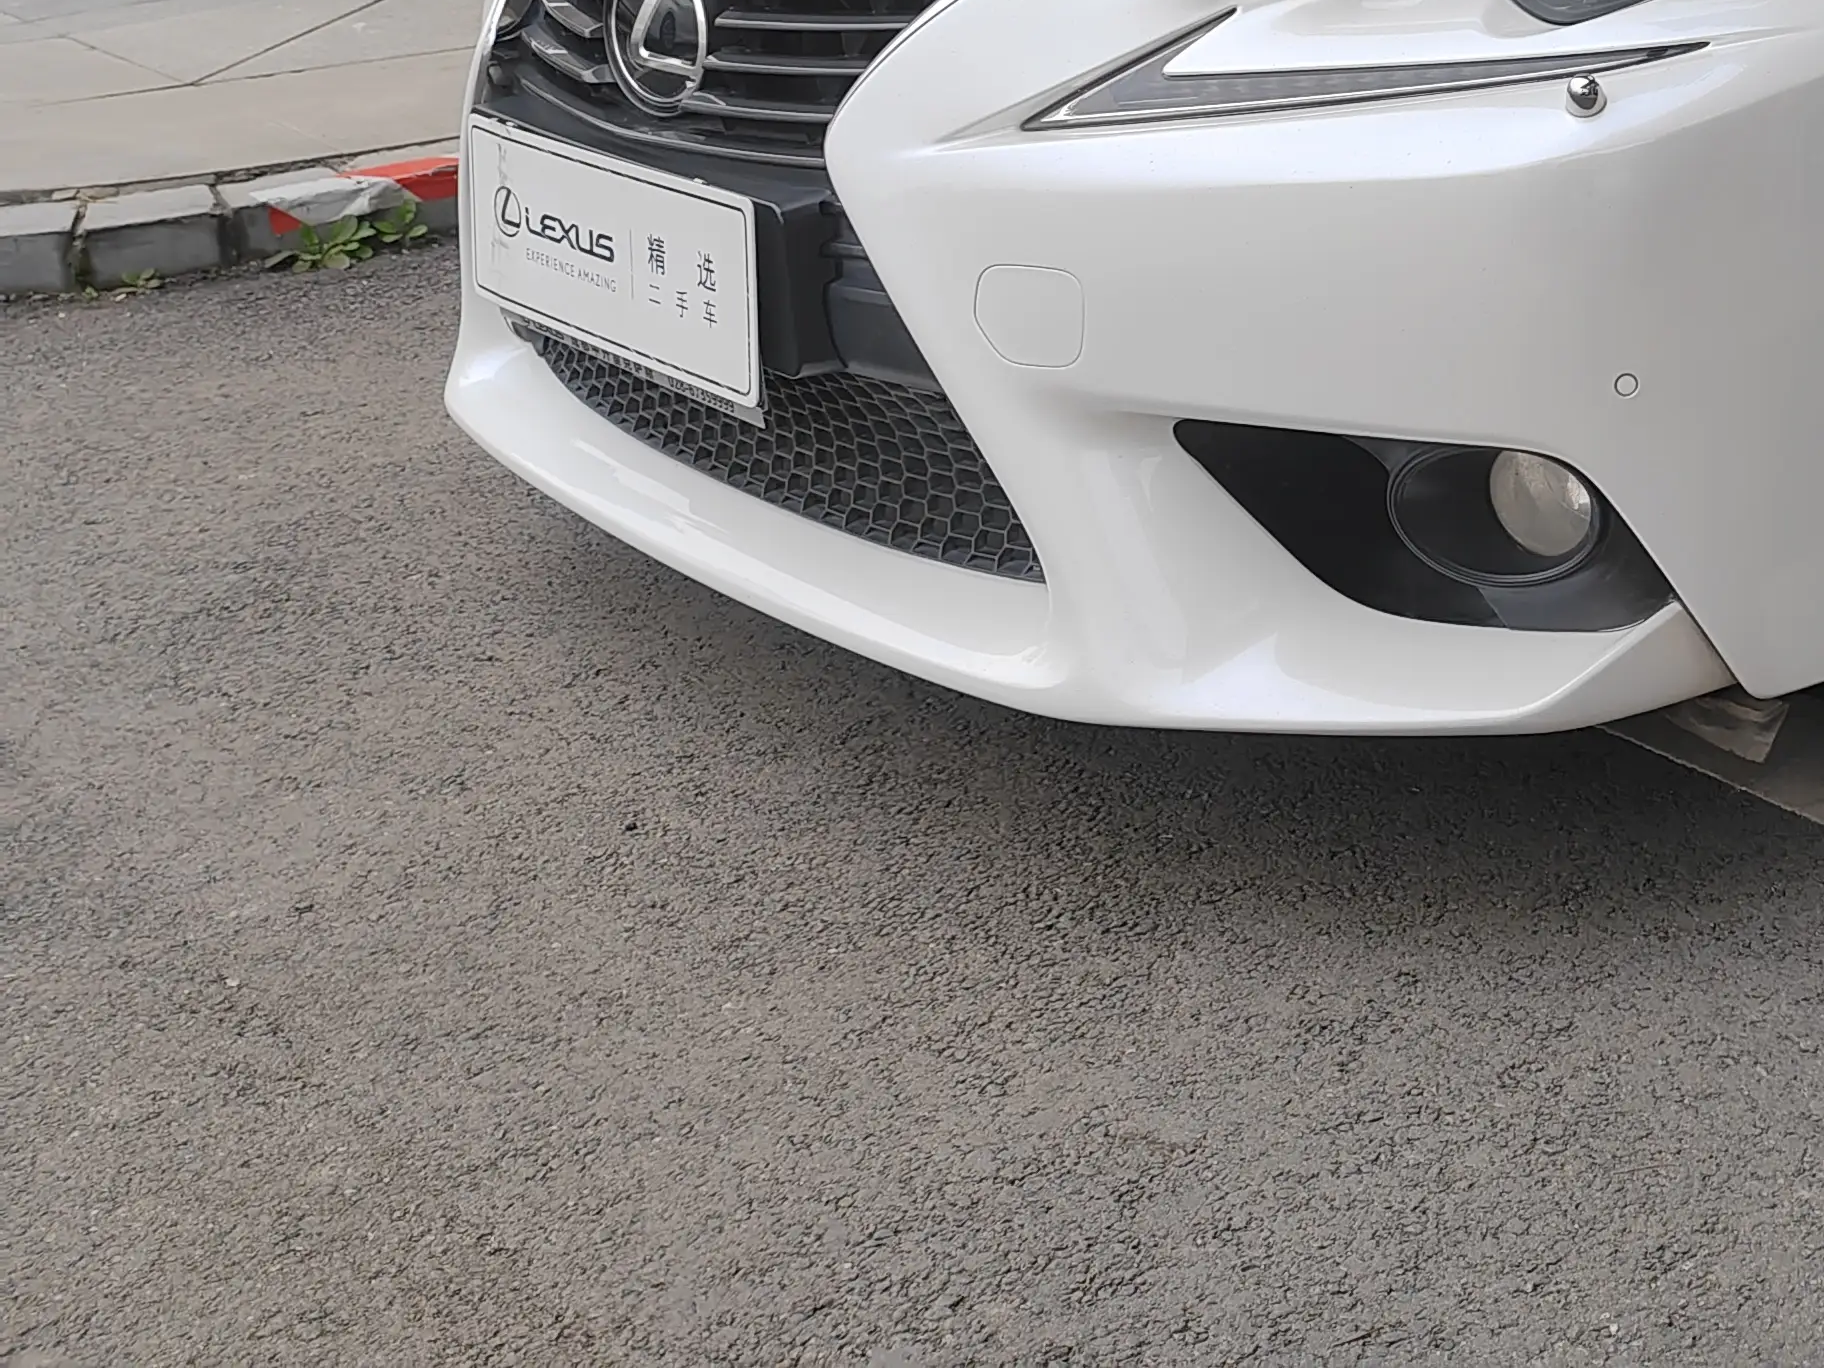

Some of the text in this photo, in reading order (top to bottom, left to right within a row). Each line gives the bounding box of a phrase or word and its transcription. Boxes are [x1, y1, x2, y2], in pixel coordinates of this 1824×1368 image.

[524, 206, 616, 264] LEXUS
[525, 247, 618, 294] EXPERIENCE AMAZING
[646, 233, 718, 294] 精选
[647, 283, 718, 329] 二手车
